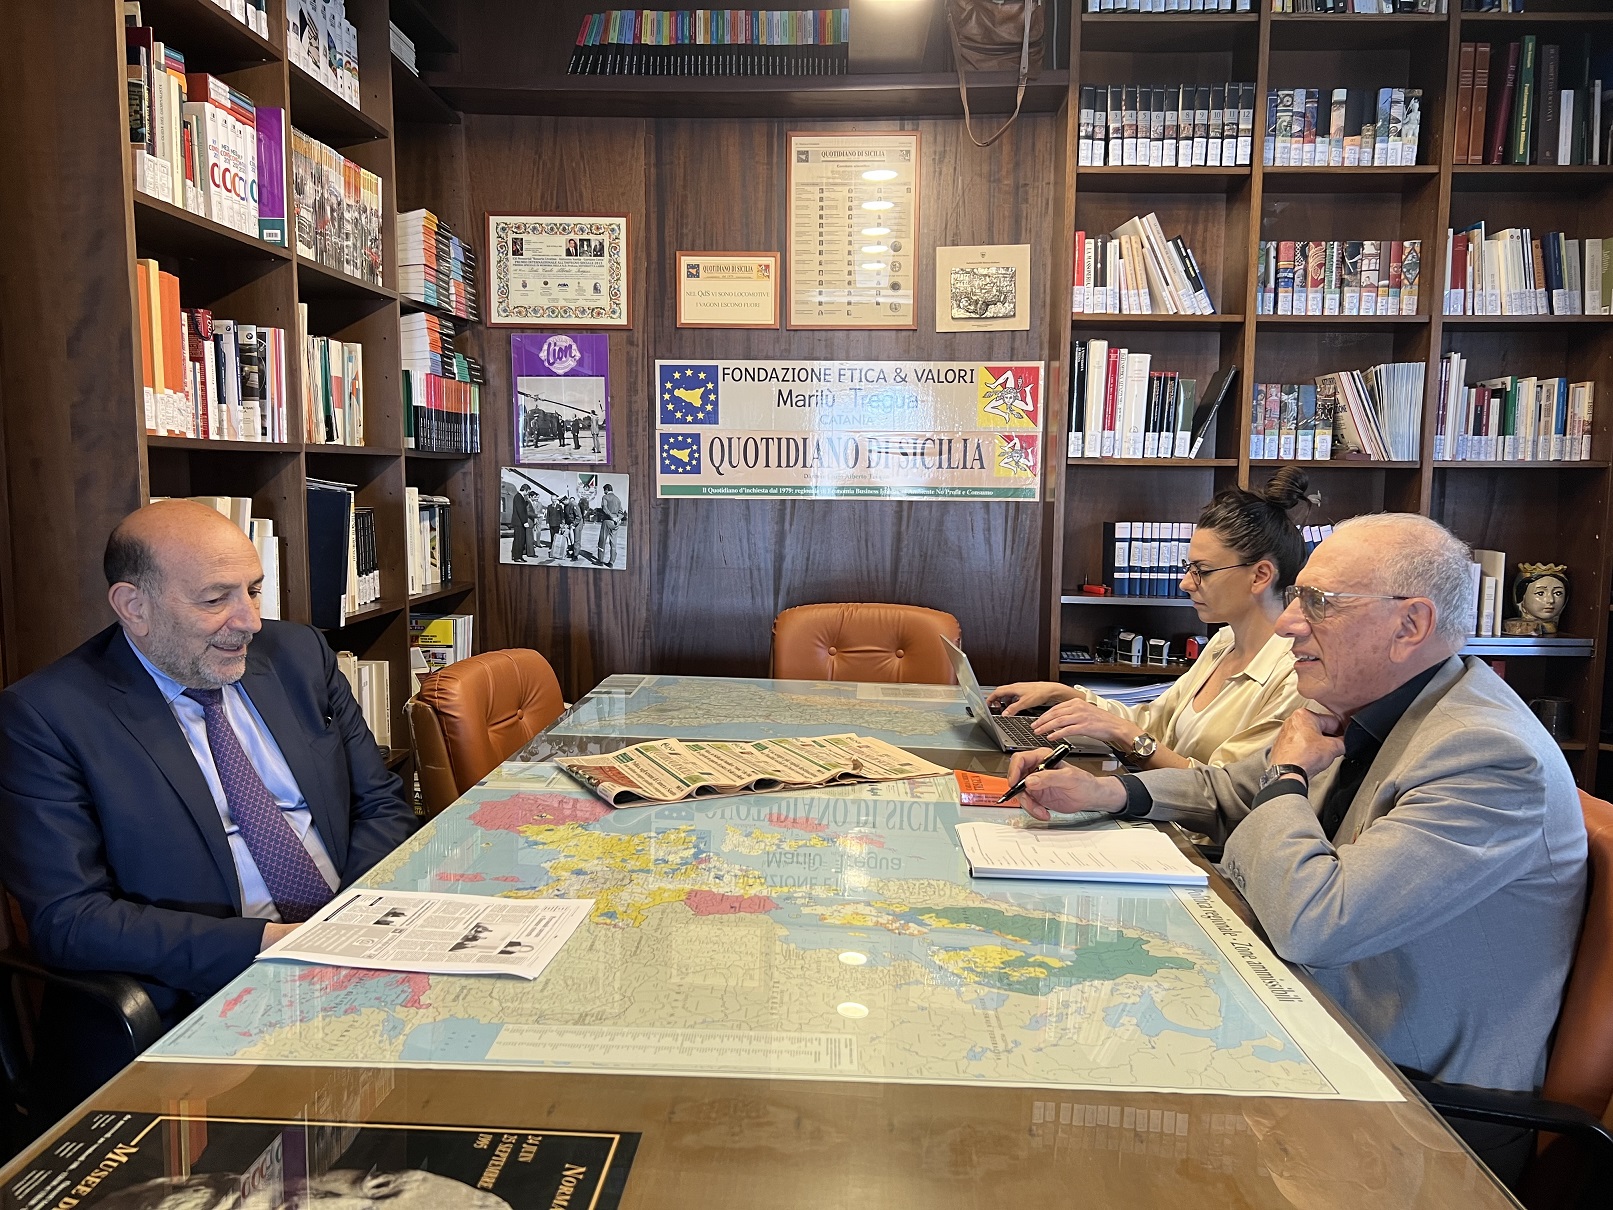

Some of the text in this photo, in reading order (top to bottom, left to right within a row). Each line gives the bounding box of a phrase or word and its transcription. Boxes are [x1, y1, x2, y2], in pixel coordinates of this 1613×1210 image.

[703, 264, 730, 273] QUOTIDIANO
[722, 367, 975, 383] FONDAZIONE ETICA & VALORI
[777, 388, 836, 408] Marilù
[820, 414, 874, 425] CATANIA
[709, 436, 986, 476] QUOTIDIANO DI SICILIA
[1200, 908, 1242, 937] regionale
[1230, 942, 1257, 959] Zone
[517, 1144, 538, 1163] JUIN
[477, 1143, 513, 1190] SEPTEMBRE
